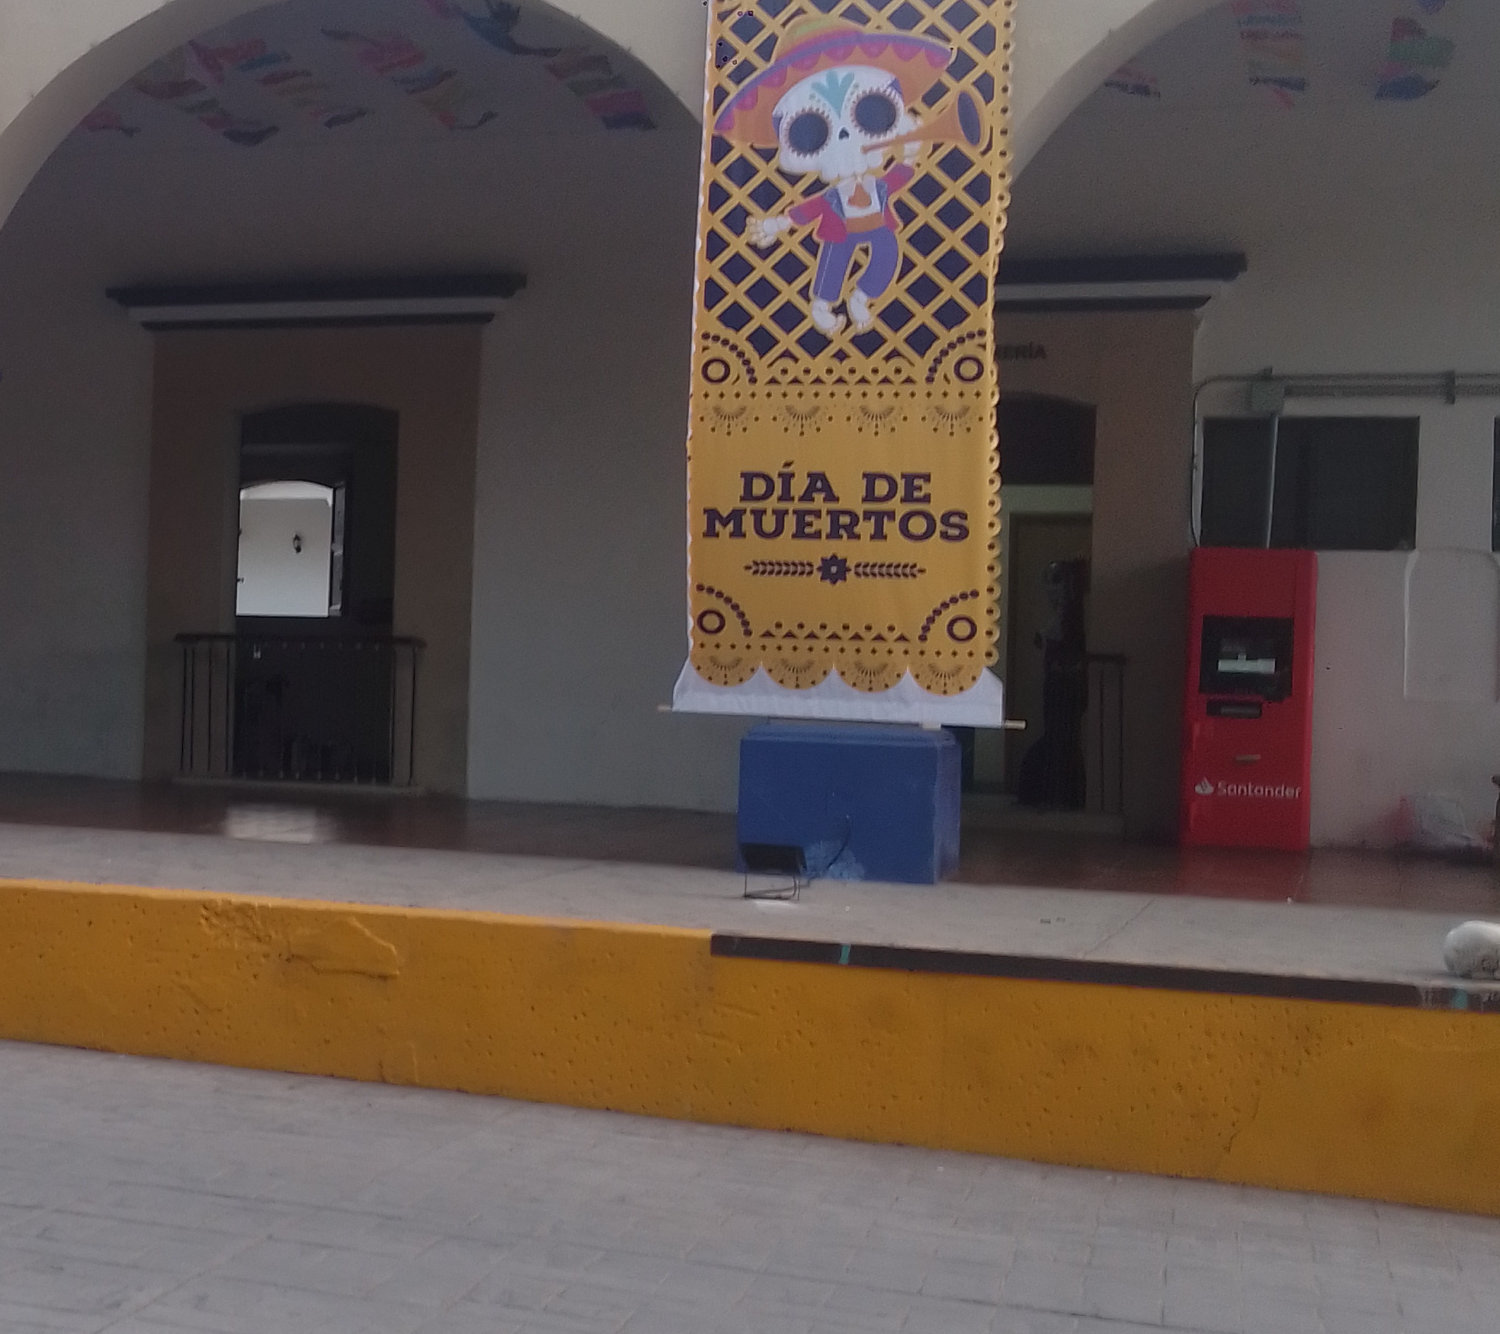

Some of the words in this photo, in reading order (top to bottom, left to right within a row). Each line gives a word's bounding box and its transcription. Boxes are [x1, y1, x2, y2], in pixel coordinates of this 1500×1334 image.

[739, 460, 840, 503] DÍA
[861, 471, 932, 504] DE
[702, 507, 970, 542] MUERTOS
[1217, 780, 1301, 799] Santander
